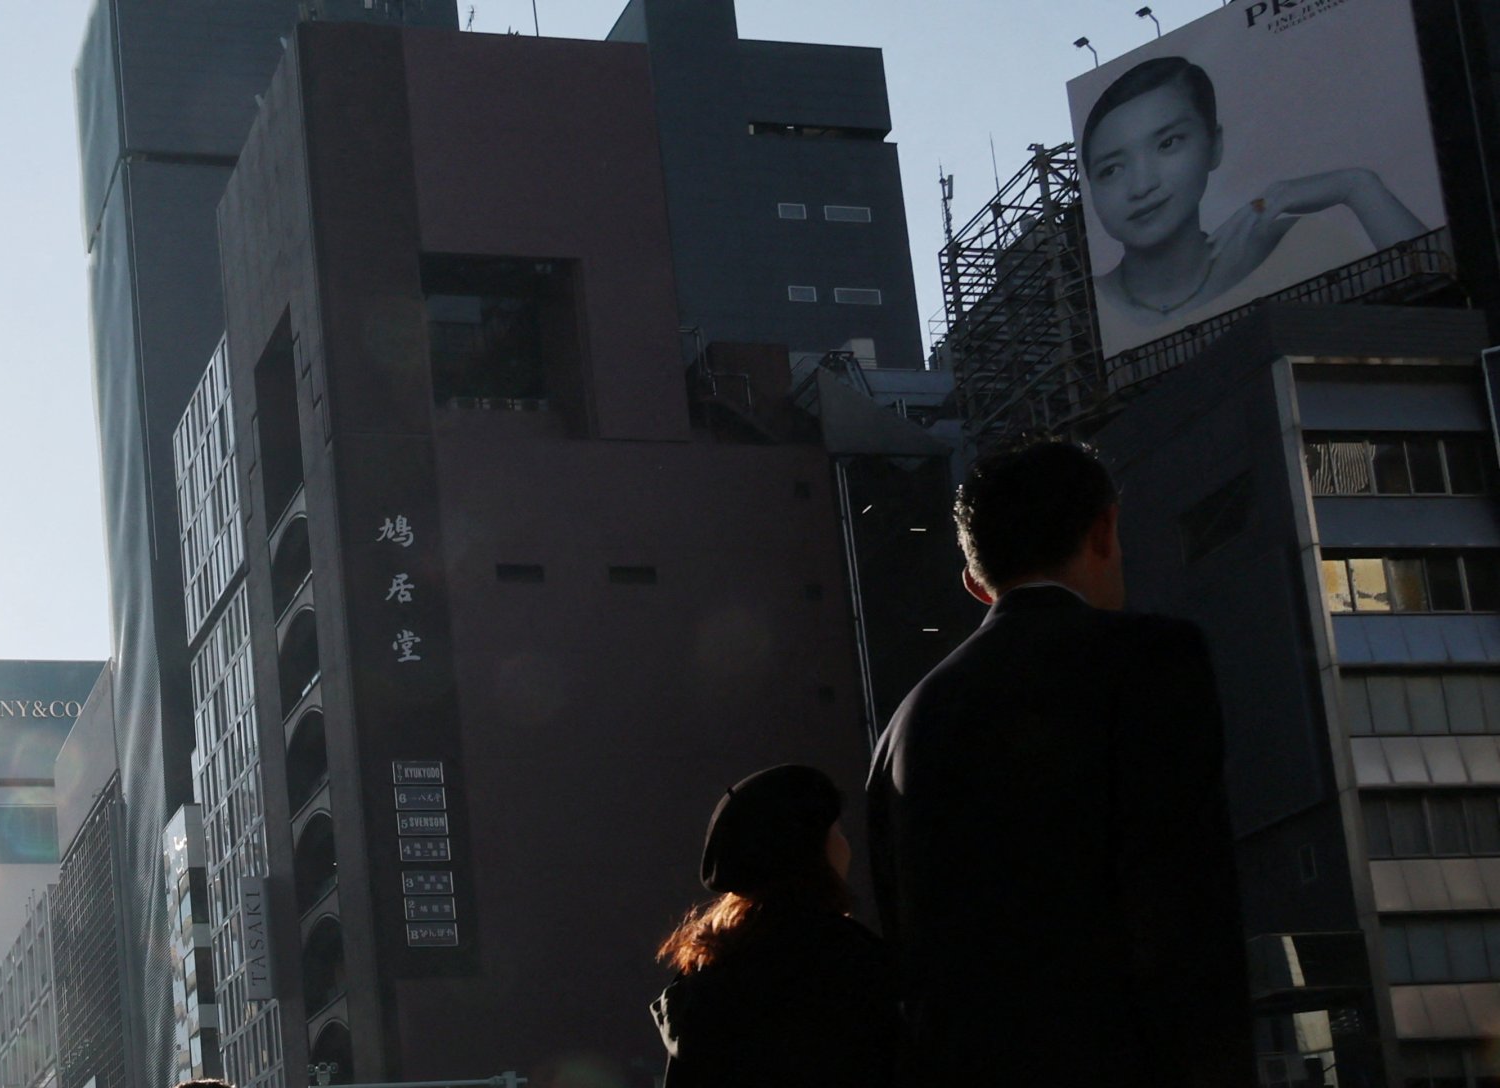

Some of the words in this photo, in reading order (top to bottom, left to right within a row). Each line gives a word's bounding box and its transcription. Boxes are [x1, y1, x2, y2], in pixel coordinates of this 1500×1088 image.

[375, 514, 421, 663] 鳩居堂
[404, 767, 440, 779] KYUKYODO
[398, 793, 407, 804] 6
[401, 819, 409, 829] 5
[409, 816, 445, 828] SVENSON
[405, 878, 414, 888] 3
[245, 891, 268, 987] TASAKI
[411, 930, 419, 940] B
